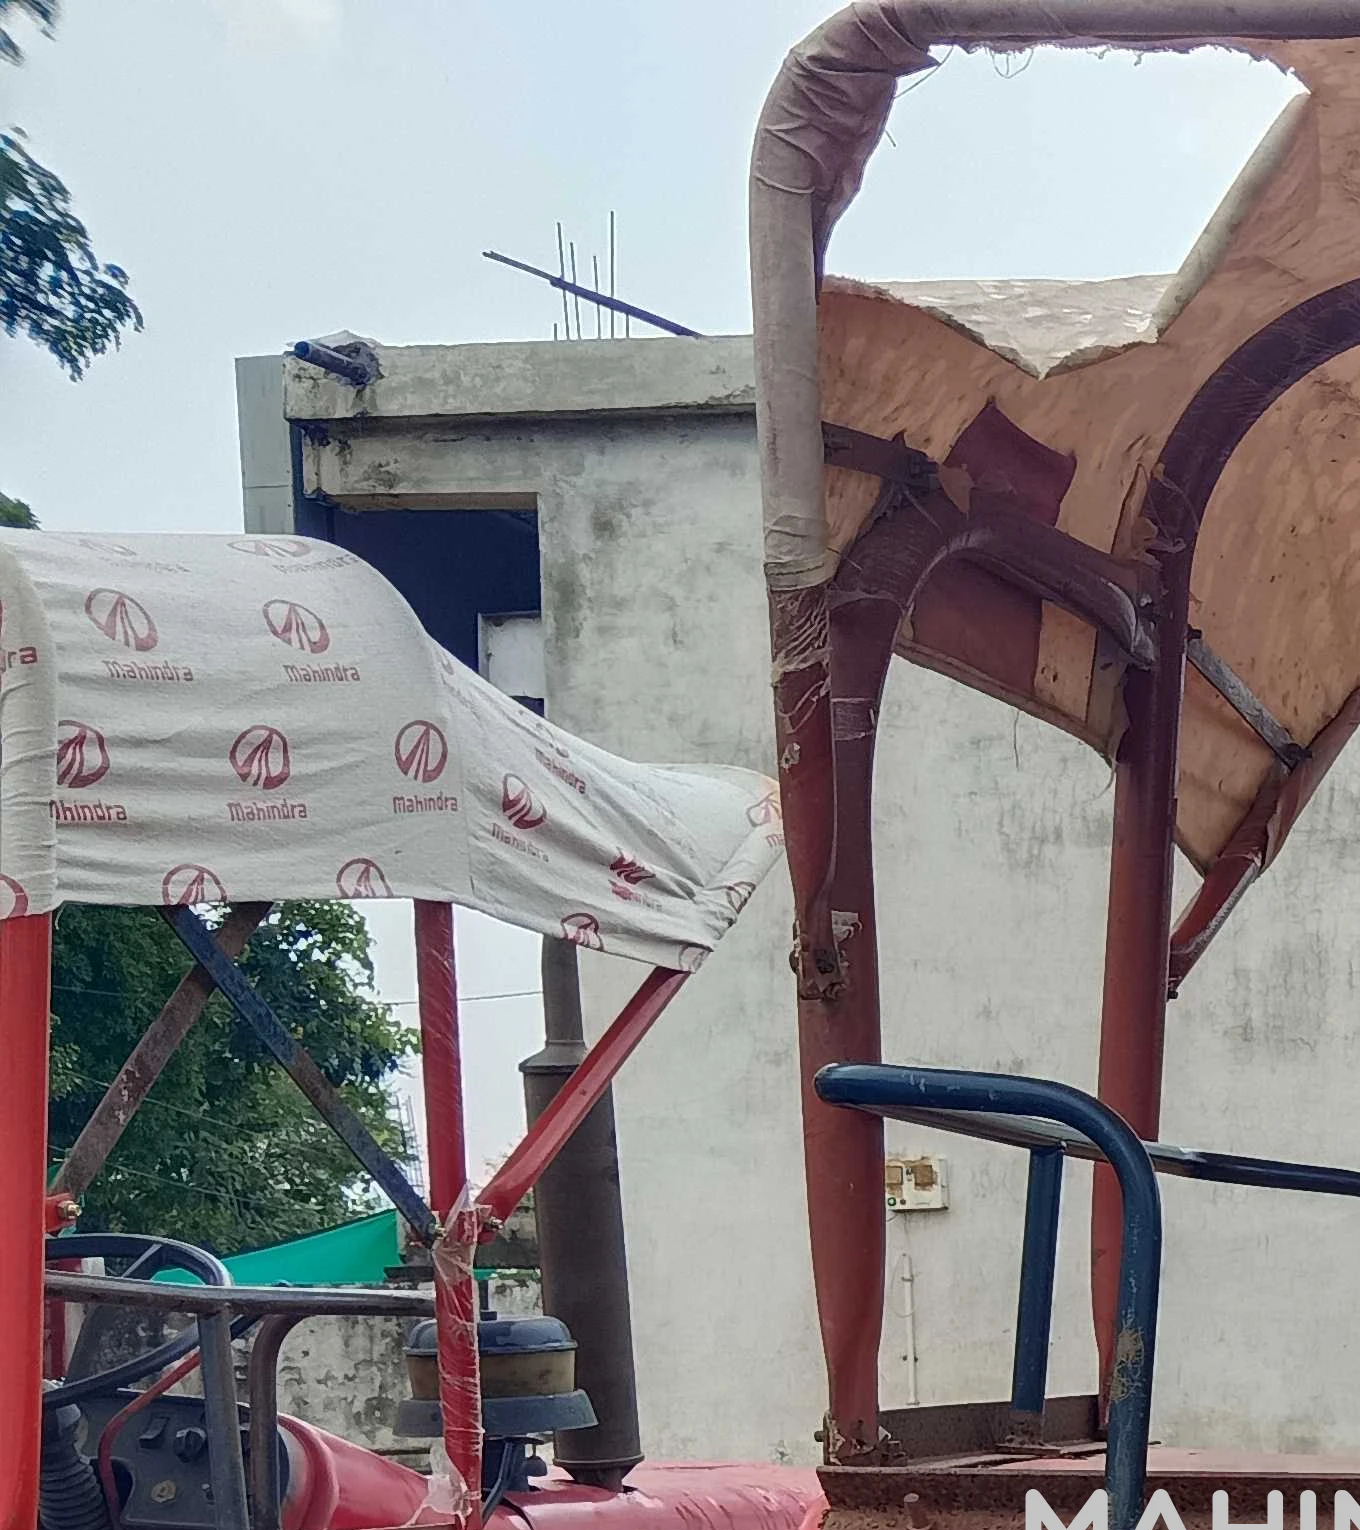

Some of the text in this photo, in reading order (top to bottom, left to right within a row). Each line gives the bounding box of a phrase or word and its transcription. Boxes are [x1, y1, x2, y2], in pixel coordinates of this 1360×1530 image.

[103, 659, 195, 682] Mahindra
[283, 664, 361, 682] Mahindra
[229, 801, 308, 822] Mahindra
[393, 791, 459, 814] Mahindra
